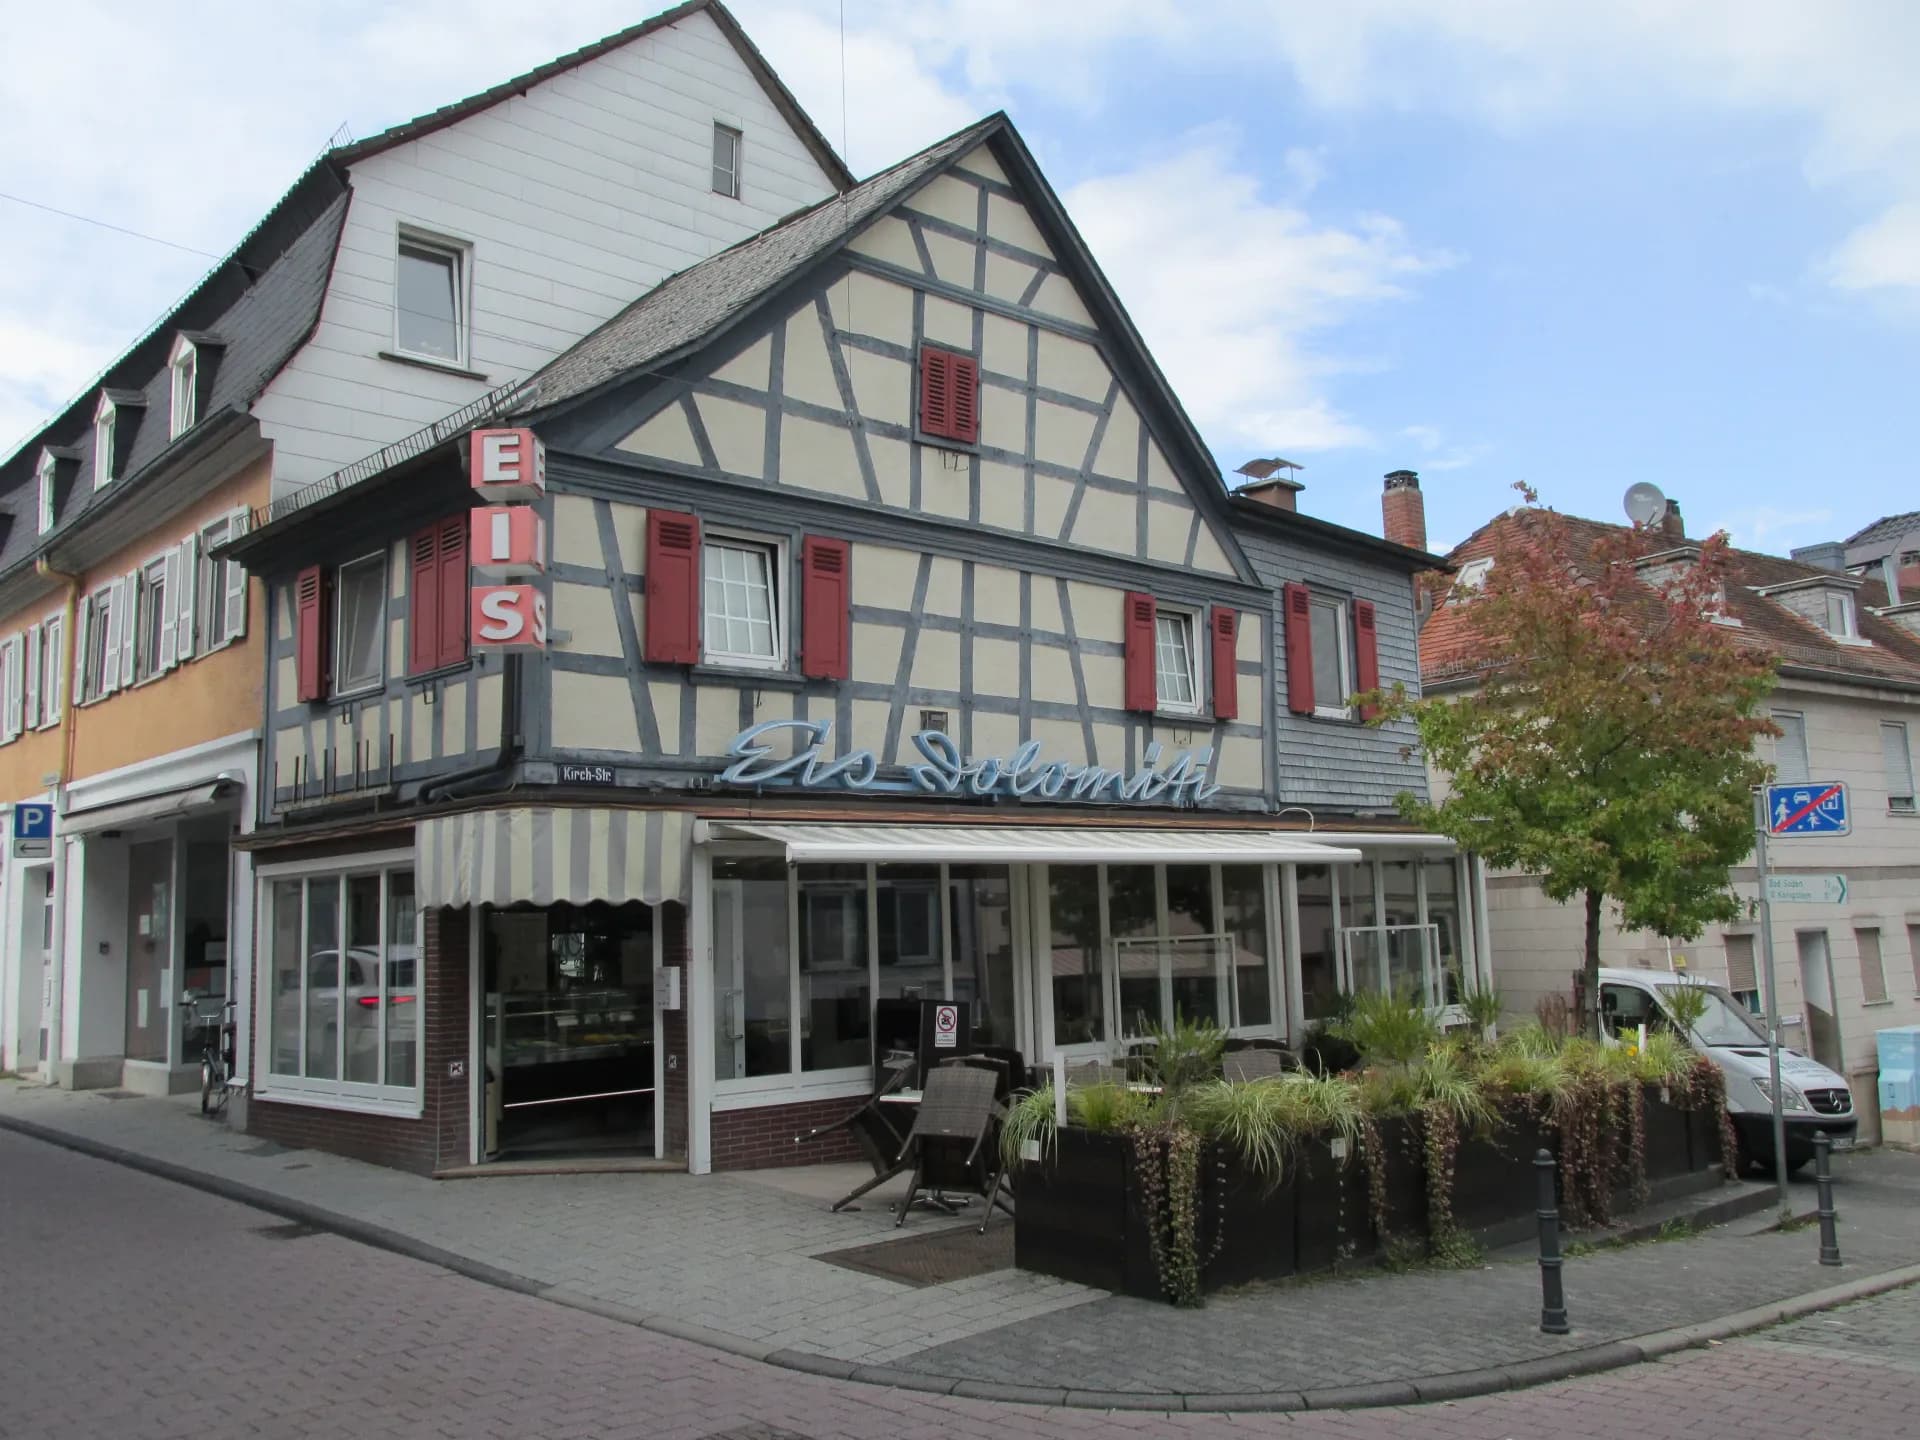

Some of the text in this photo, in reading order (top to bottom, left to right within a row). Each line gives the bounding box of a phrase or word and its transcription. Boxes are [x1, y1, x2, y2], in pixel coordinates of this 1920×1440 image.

[480, 435, 524, 641] EIS
[563, 766, 612, 782] Kirch-Str.
[721, 719, 877, 787] Eis
[903, 730, 1221, 801] Dolomiti
[23, 807, 44, 835] P
